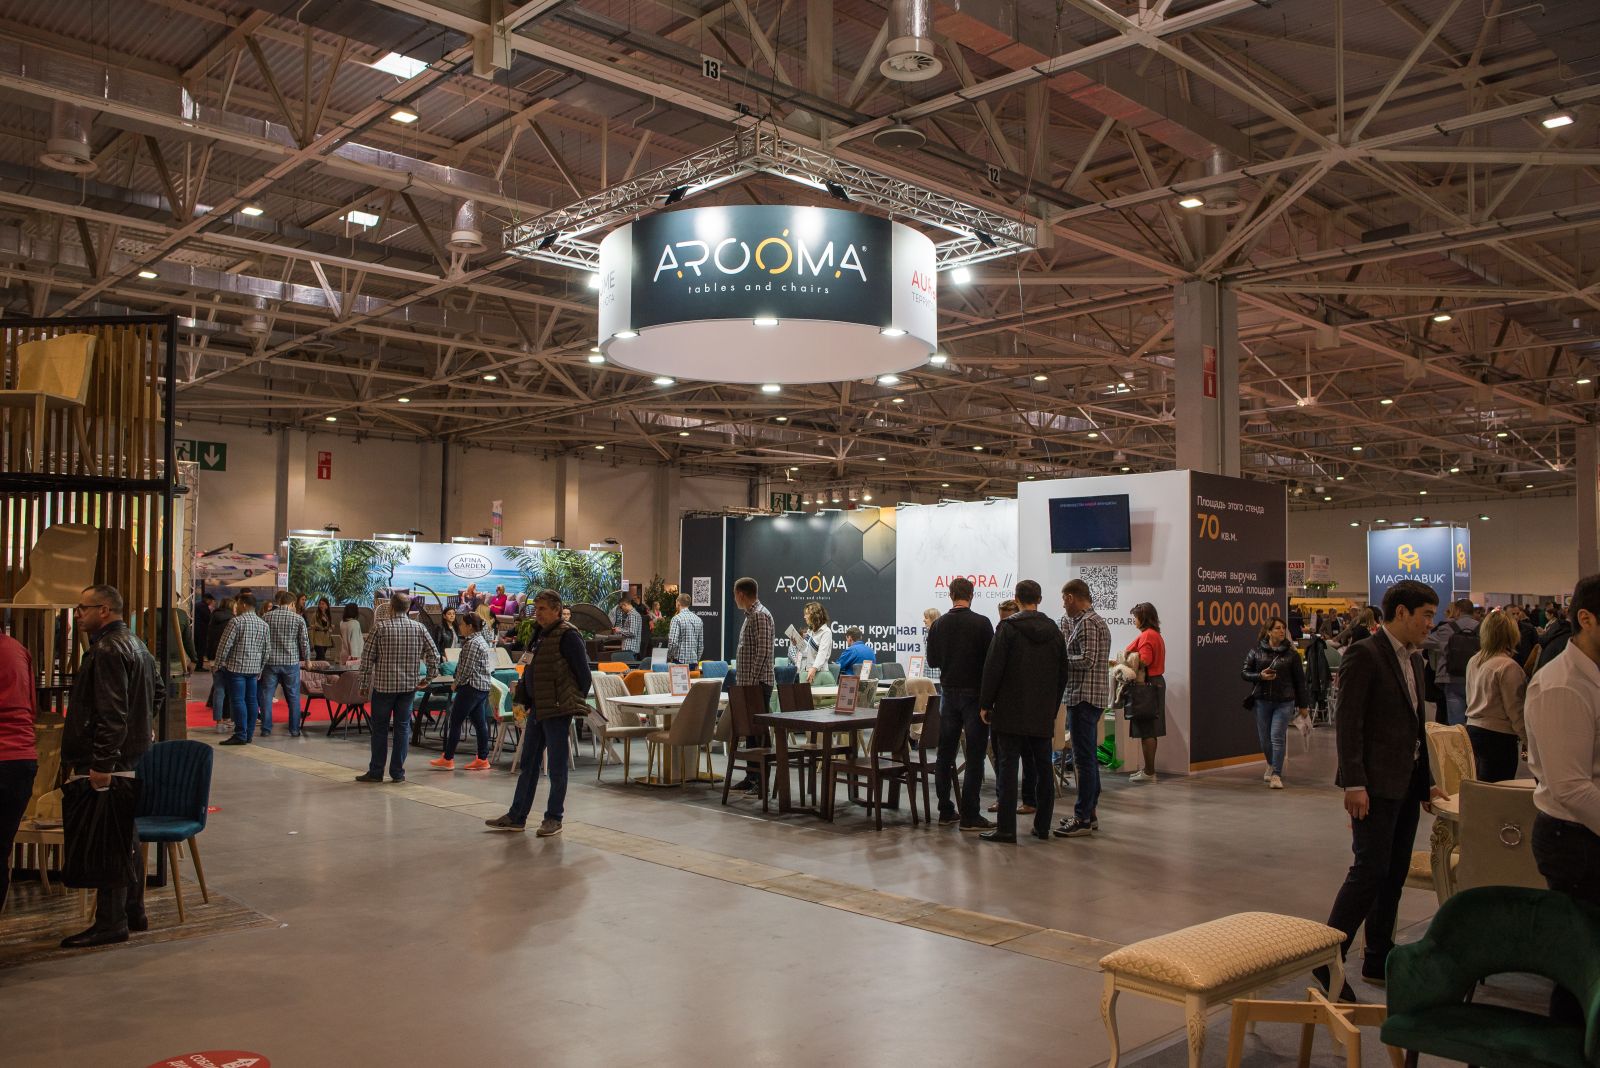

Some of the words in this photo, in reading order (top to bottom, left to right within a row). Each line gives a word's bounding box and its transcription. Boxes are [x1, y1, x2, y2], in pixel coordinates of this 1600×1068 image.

[704, 60, 718, 79] 13
[989, 167, 999, 183] 12
[688, 282, 735, 294] tables
[745, 281, 772, 291] and
[781, 281, 829, 294] chairs
[1197, 495, 1226, 510] Площадь
[1227, 502, 1243, 512] этого
[1245, 504, 1265, 515] стенда
[1197, 513, 1220, 540] 70
[1221, 532, 1238, 541] кв.м.
[935, 575, 998, 588] AUORA
[1197, 567, 1227, 580] Средняя
[1229, 571, 1257, 583] выручка
[1375, 573, 1445, 584] MAGNABUK
[1197, 583, 1222, 593] салона
[1225, 584, 1243, 594] такой
[1246, 586, 1275, 596] площади
[868, 625, 917, 638] крупная
[864, 637, 921, 654] франшиз
